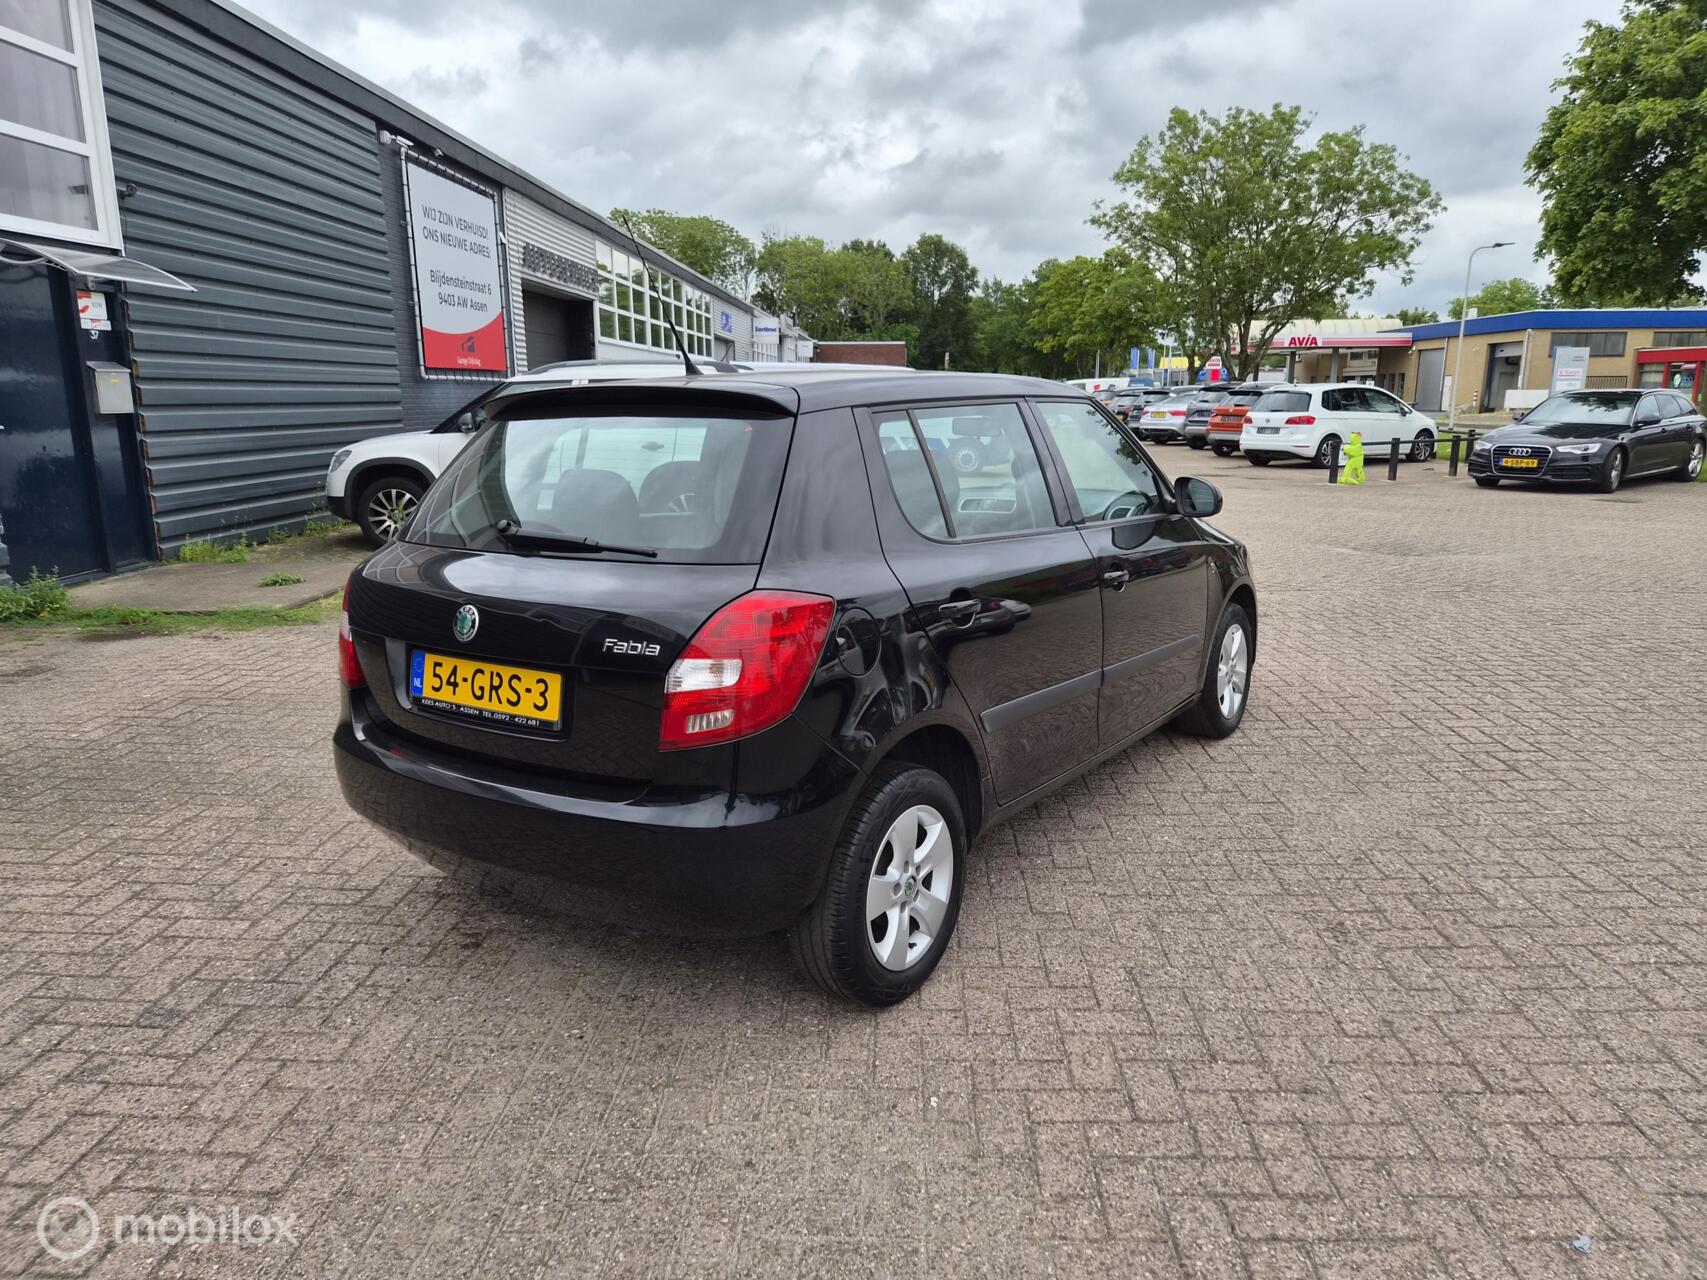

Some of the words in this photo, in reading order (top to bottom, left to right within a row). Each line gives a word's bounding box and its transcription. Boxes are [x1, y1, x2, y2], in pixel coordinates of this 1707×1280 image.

[422, 204, 436, 221] WIJ
[438, 210, 453, 227] ZIJN
[454, 216, 489, 240] VERHUISD!
[422, 226, 439, 243] ONS
[440, 231, 468, 252] NIEUWE
[469, 241, 491, 259] ADRES:
[430, 269, 487, 295] Blijdensteinstraat
[438, 291, 456, 307] 9403
[457, 296, 468, 309] AW
[470, 298, 488, 313] Assen
[1288, 334, 1318, 347] AVIA
[602, 638, 661, 657] Fabia
[413, 677, 423, 688] NL
[431, 660, 550, 713] 54-GRS-3
[421, 698, 434, 706] KEES
[460, 707, 480, 715] ASSEN
